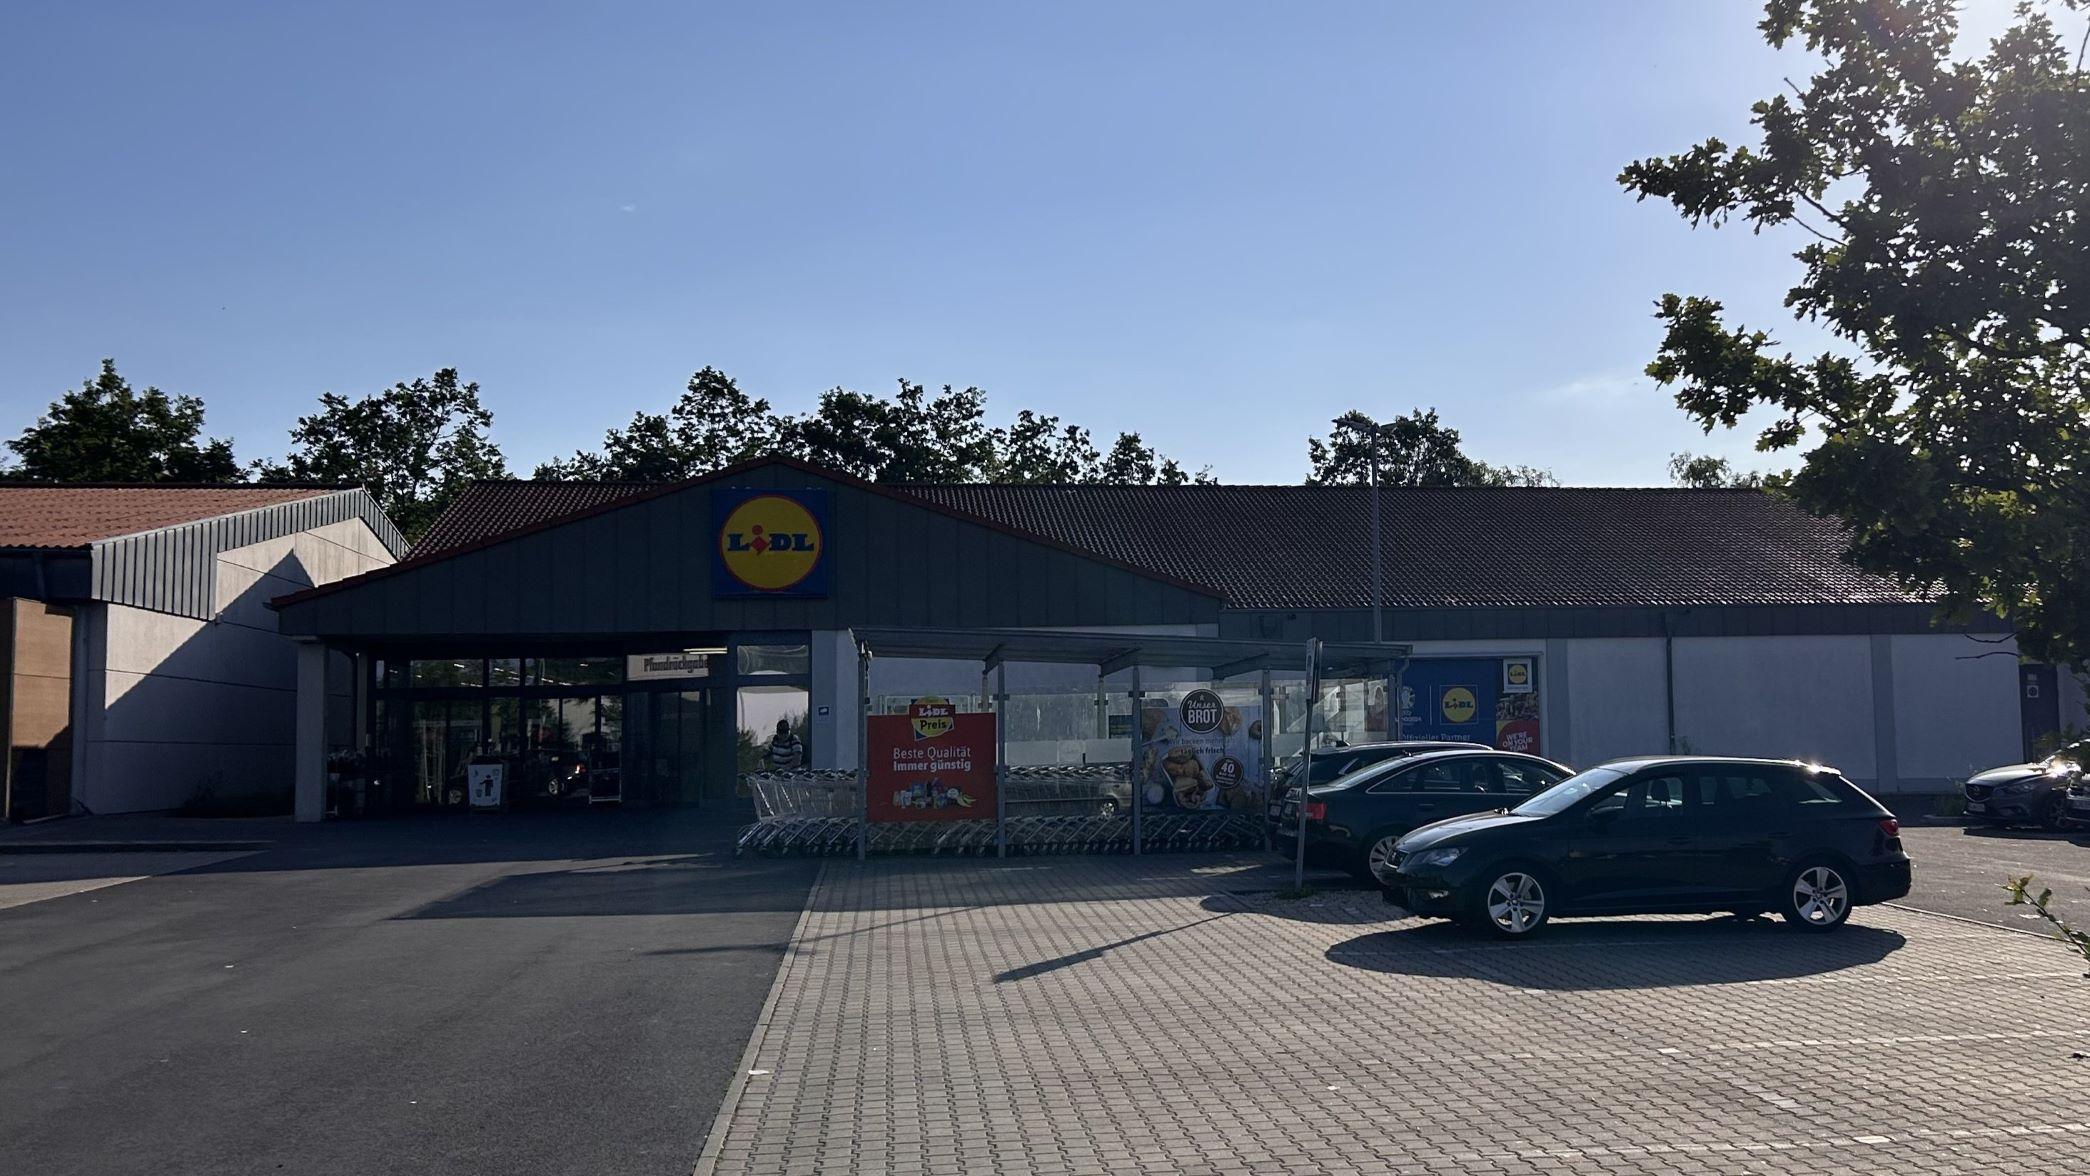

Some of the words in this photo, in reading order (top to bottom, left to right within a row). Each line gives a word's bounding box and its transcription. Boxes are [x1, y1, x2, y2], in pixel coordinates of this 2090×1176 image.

[1187, 700, 1217, 709] Unser
[1188, 709, 1217, 724] BROT
[920, 719, 947, 730] Preis
[893, 747, 924, 759] Beste
[927, 745, 971, 760] Qualität
[893, 761, 928, 771] Immer
[930, 759, 971, 772] günstig
[1220, 762, 1235, 773] 40
